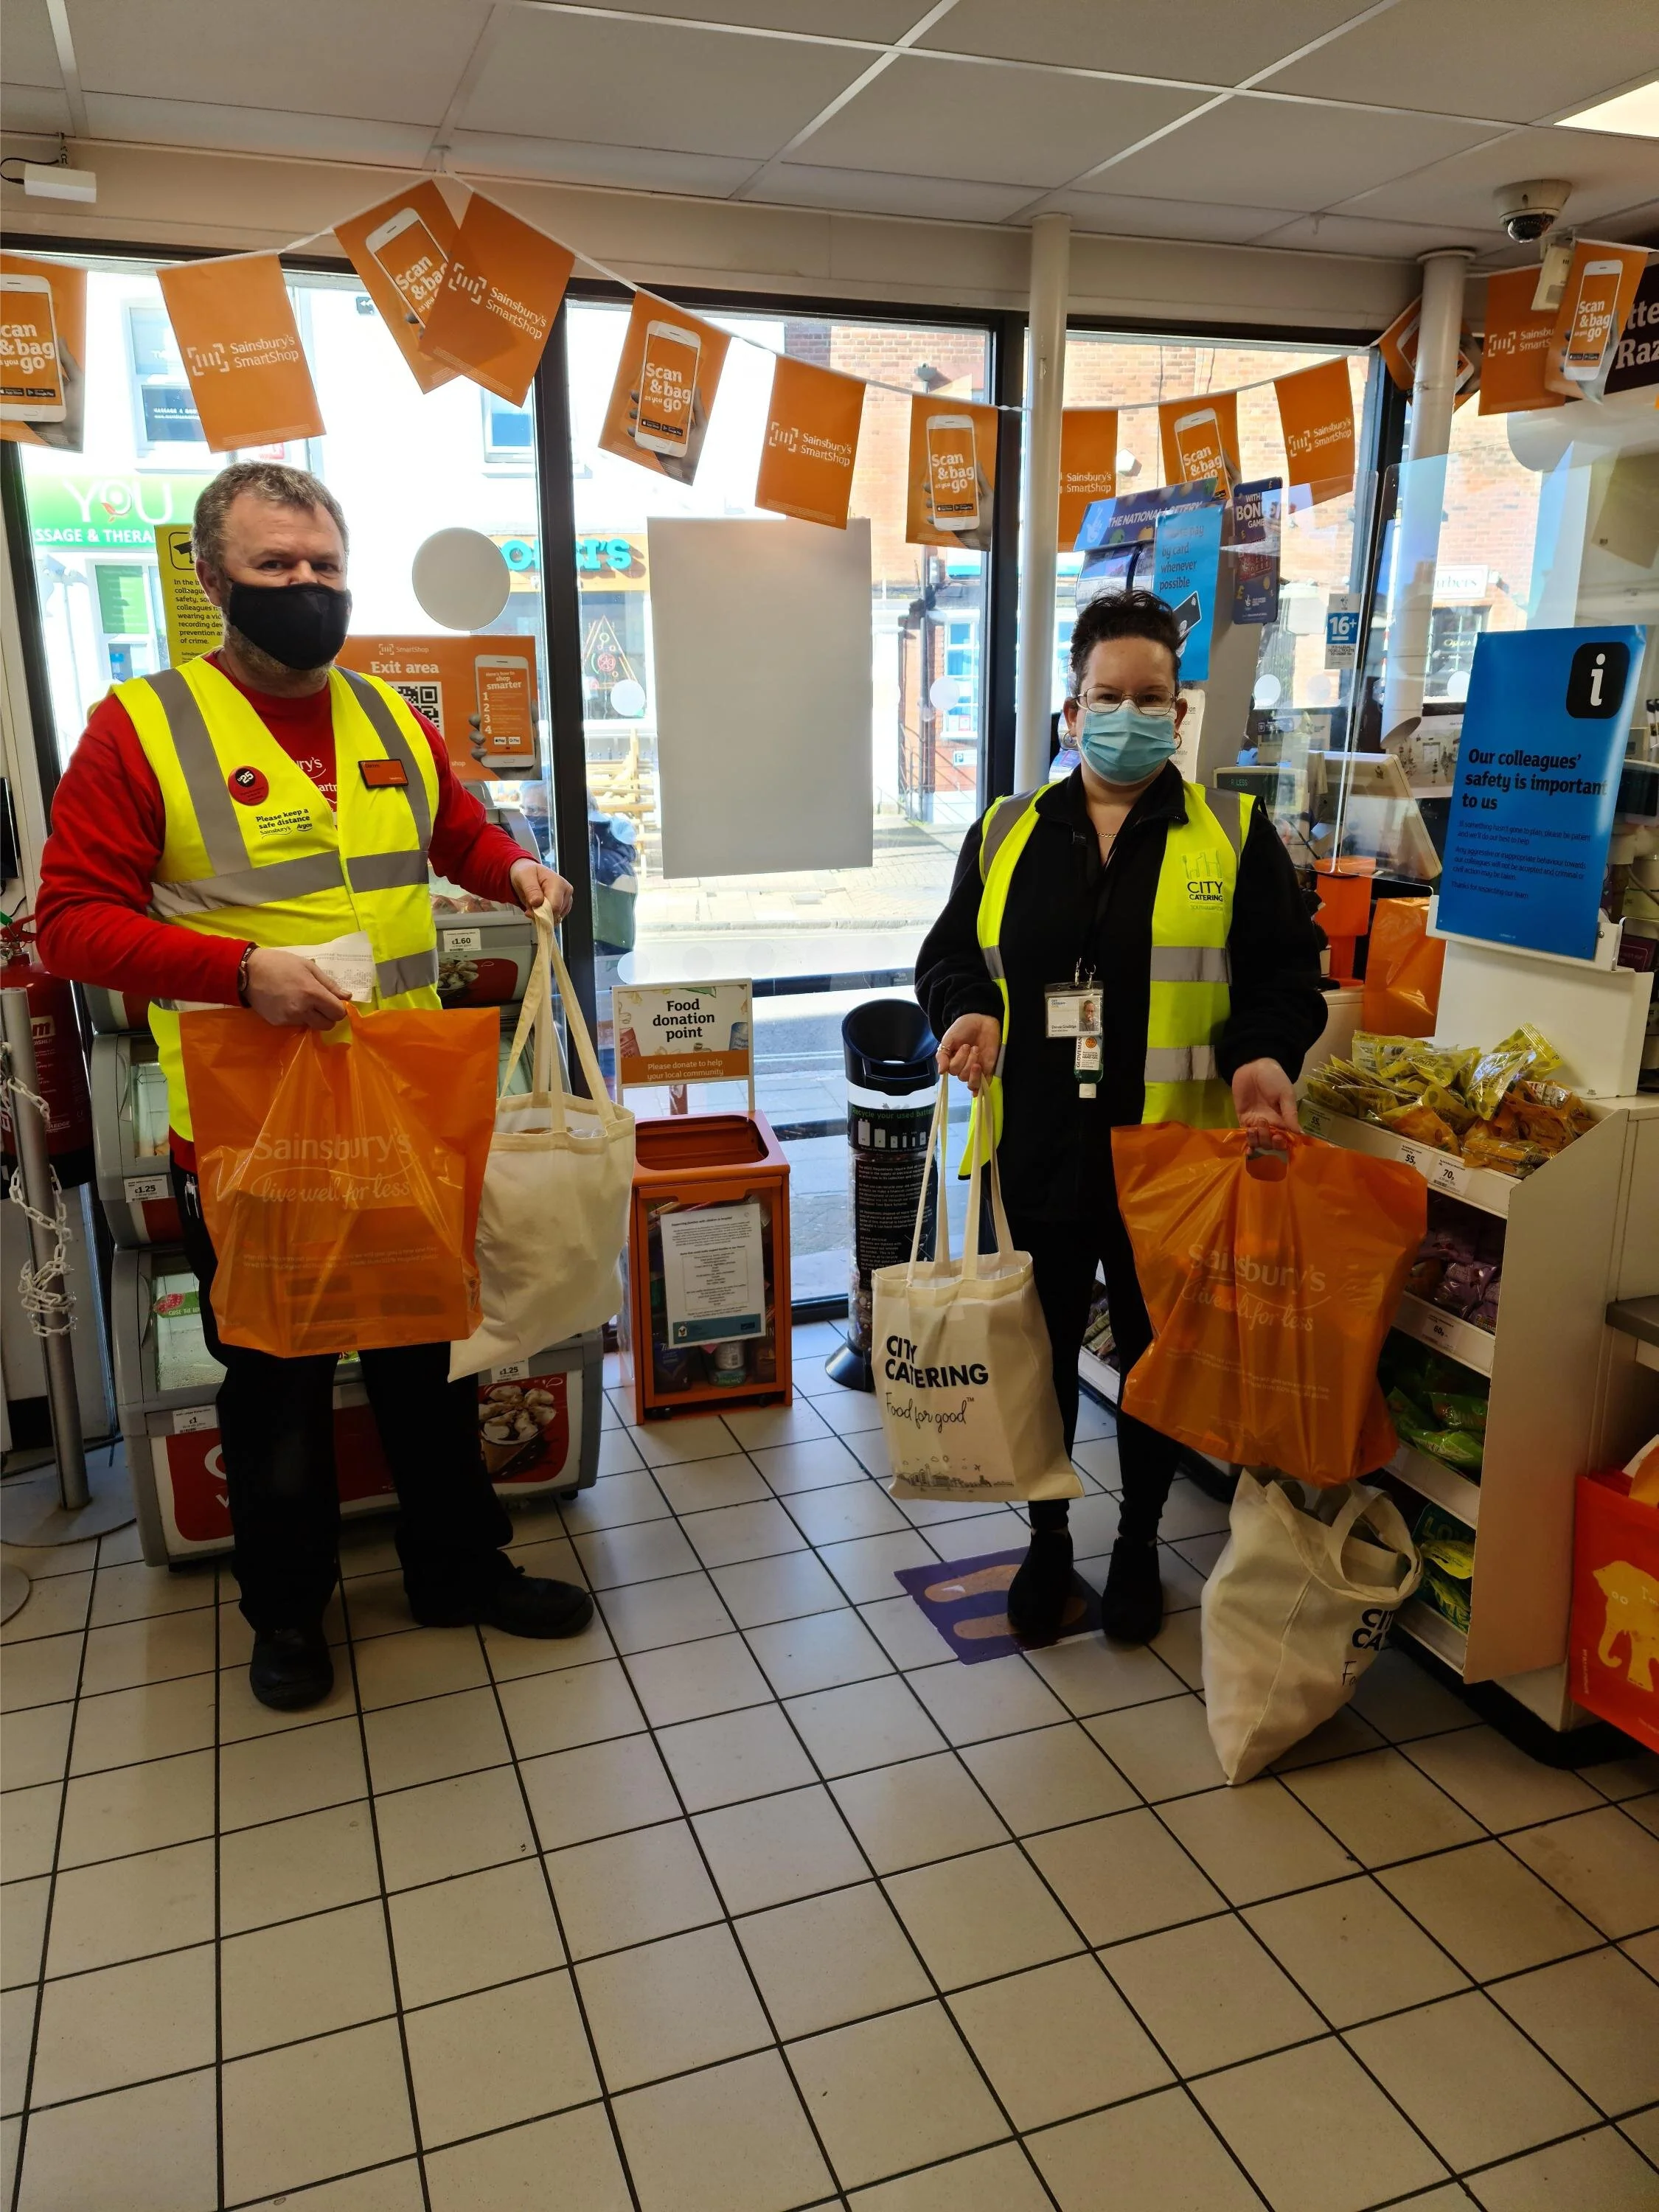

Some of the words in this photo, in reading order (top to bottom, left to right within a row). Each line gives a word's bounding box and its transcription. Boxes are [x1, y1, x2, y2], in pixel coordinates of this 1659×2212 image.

[395, 256, 433, 290] Scan
[422, 262, 447, 288] ba
[490, 287, 547, 327] Sainsbury's
[1579, 300, 1604, 314] Scan
[486, 299, 543, 339] SmartShop
[1590, 313, 1611, 329] bag
[0, 324, 37, 338] can
[1520, 328, 1554, 341] Sainsbu
[1587, 327, 1601, 342] go
[16, 338, 55, 359] bag
[230, 335, 295, 354] Sainsbury's
[1520, 338, 1551, 352] SmartS
[21, 357, 45, 374] go
[234, 350, 299, 367] SmartShop
[646, 362, 682, 383] Scan
[664, 381, 691, 404] bag
[664, 398, 682, 413] go
[1313, 417, 1351, 437] Sainsbury's
[802, 433, 852, 454] Sainsbury's
[1314, 429, 1352, 448] SmartShop
[801, 445, 850, 467] SmartShop
[931, 453, 964, 467] Scan
[1183, 446, 1212, 466] Scan
[1199, 455, 1222, 472] bag
[949, 466, 974, 480] bag
[1066, 472, 1111, 484] Sainsbury's
[951, 479, 968, 493] go
[1066, 484, 1111, 493] SmartShop
[61, 479, 173, 525] YOU
[1245, 493, 1261, 502] WITH
[1109, 516, 1121, 527] THE
[35, 528, 83, 543] SSAGE
[87, 529, 100, 543] &
[103, 529, 154, 543] THERA
[1189, 526, 1203, 537] pay
[1162, 546, 1171, 559] by
[1173, 543, 1189, 554] card
[1161, 560, 1197, 573] whenever
[1159, 577, 1190, 591] possible
[1329, 616, 1357, 635] 16+
[396, 646, 429, 654] SmartShop
[372, 661, 402, 674] Exit
[406, 663, 439, 674] area
[487, 681, 521, 690] smarter
[483, 692, 489, 700] 1
[484, 703, 490, 712] 2
[484, 714, 490, 723] 3
[484, 726, 492, 734] 4
[1469, 748, 1495, 764] Our
[1498, 750, 1582, 771] colleagues'
[1465, 772, 1511, 793] safety
[1514, 775, 1526, 789] is
[1531, 775, 1607, 796] important
[1463, 793, 1477, 809] to
[1481, 798, 1498, 810] us
[277, 815, 310, 825] distance
[260, 826, 291, 834] Sainsbury's
[1464, 822, 1492, 832] something
[1544, 830, 1562, 838] please
[1571, 833, 1590, 841] patient
[1501, 852, 1535, 862] inappropriate
[1537, 856, 1563, 866] behaviour
[1565, 861, 1586, 869] towards
[1464, 858, 1489, 866] colleagues
[1520, 865, 1543, 874] accepted
[1555, 870, 1578, 879] criminal
[1481, 870, 1492, 878] may
[1187, 881, 1222, 894] CITY
[1478, 886, 1505, 895] respecting
[1189, 894, 1222, 902] CATERING
[667, 998, 700, 1012] Food
[653, 1012, 715, 1026] donation
[666, 1026, 703, 1042] point
[672, 1061, 698, 1069] donate
[707, 1059, 723, 1067] help
[665, 1070, 682, 1078] local
[683, 1069, 724, 1078] community
[254, 1128, 411, 1164] Sainsbury's
[1442, 1169, 1455, 1180] 70p
[135, 1185, 156, 1194] £1.25
[260, 1182, 295, 1203] live
[299, 1181, 338, 1202] well
[343, 1185, 369, 1210] for
[374, 1178, 410, 1198] less
[886, 1335, 918, 1363] CITY
[500, 1366, 518, 1375] £1.25
[885, 1358, 989, 1388] CATERING
[886, 1392, 912, 1421] Food
[915, 1411, 933, 1429] for
